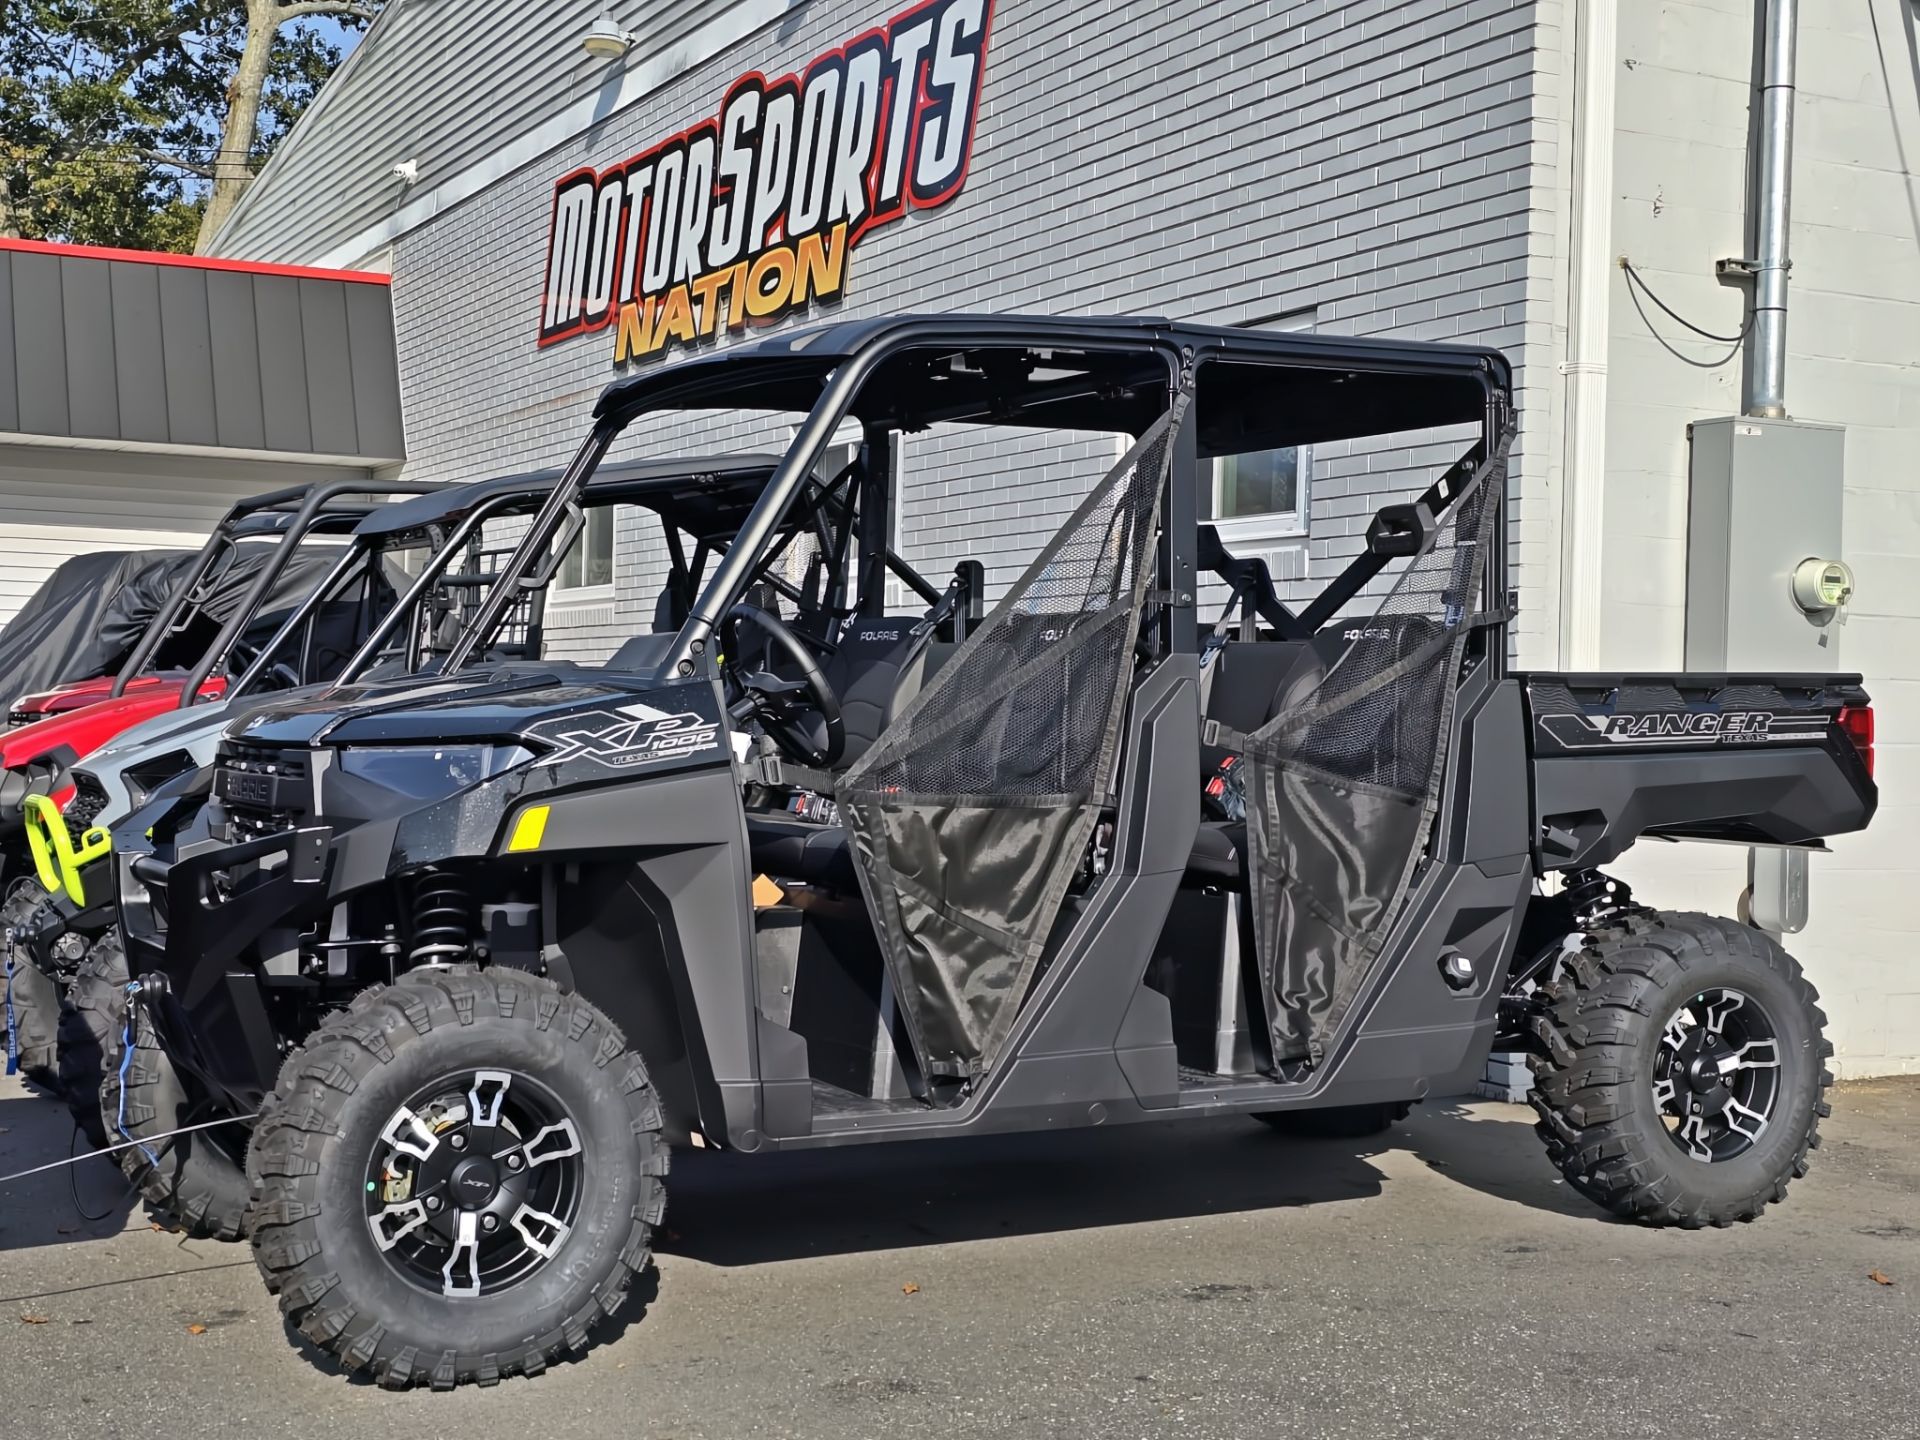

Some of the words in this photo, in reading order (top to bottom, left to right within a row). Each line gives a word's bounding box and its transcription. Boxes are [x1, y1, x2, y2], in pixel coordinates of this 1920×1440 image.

[544, 0, 984, 329] MOTORSPORTS
[614, 222, 847, 362] NATION
[861, 630, 899, 641] POLARIS
[531, 711, 720, 768] XP
[651, 731, 716, 750] 1000
[1600, 712, 1773, 736] RANGER
[1721, 732, 1769, 744] TEXAS
[6, 1003, 16, 1058] POLARIS
